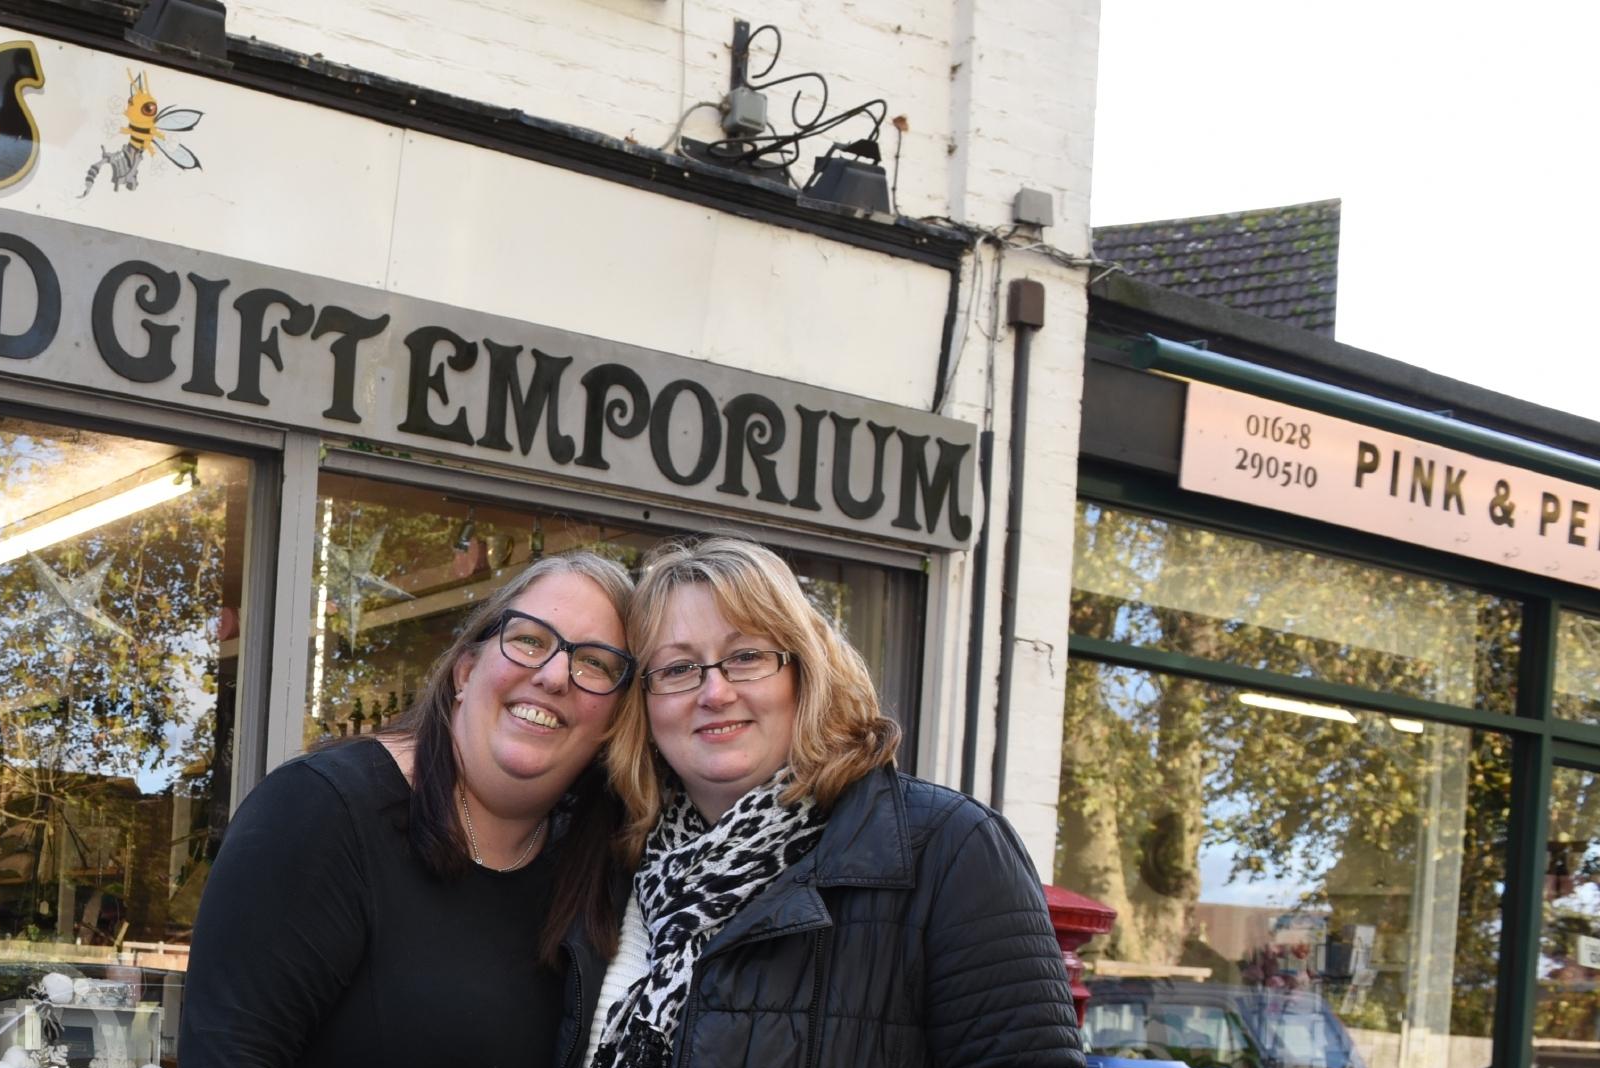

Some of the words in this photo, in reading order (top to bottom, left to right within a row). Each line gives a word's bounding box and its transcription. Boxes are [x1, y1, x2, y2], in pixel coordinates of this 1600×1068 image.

[91, 259, 390, 424] GIFT
[397, 324, 973, 542] EMPORIUM
[1246, 414, 1312, 450] 01628
[1234, 447, 1318, 489] 290510
[1354, 439, 1467, 516] PINK
[1488, 478, 1517, 529] &
[1538, 490, 1600, 552] PE
